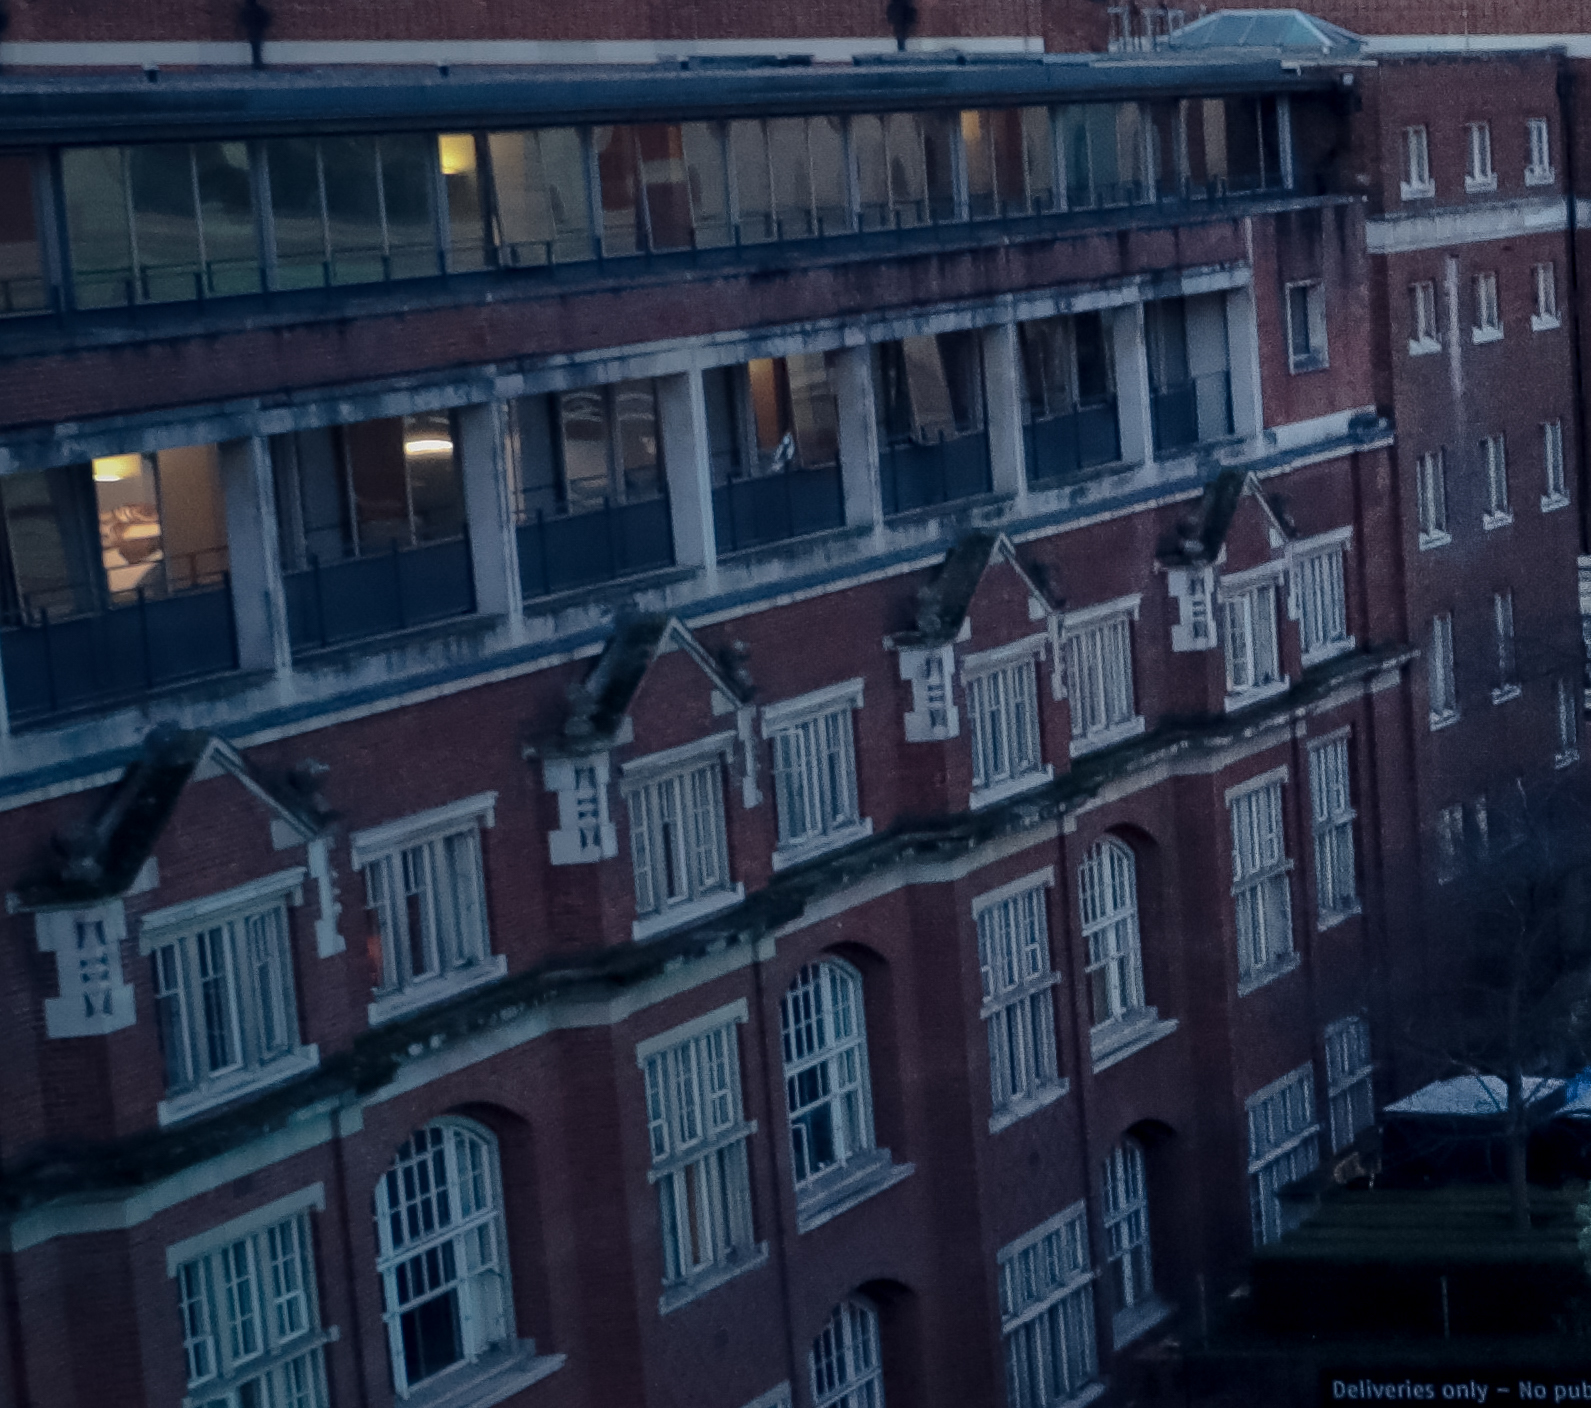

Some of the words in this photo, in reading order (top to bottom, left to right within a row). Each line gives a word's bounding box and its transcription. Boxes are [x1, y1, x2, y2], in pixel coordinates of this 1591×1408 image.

[1332, 1378, 1435, 1399] Deliveries
[1441, 1379, 1488, 1403] only
[1519, 1380, 1546, 1400] No
